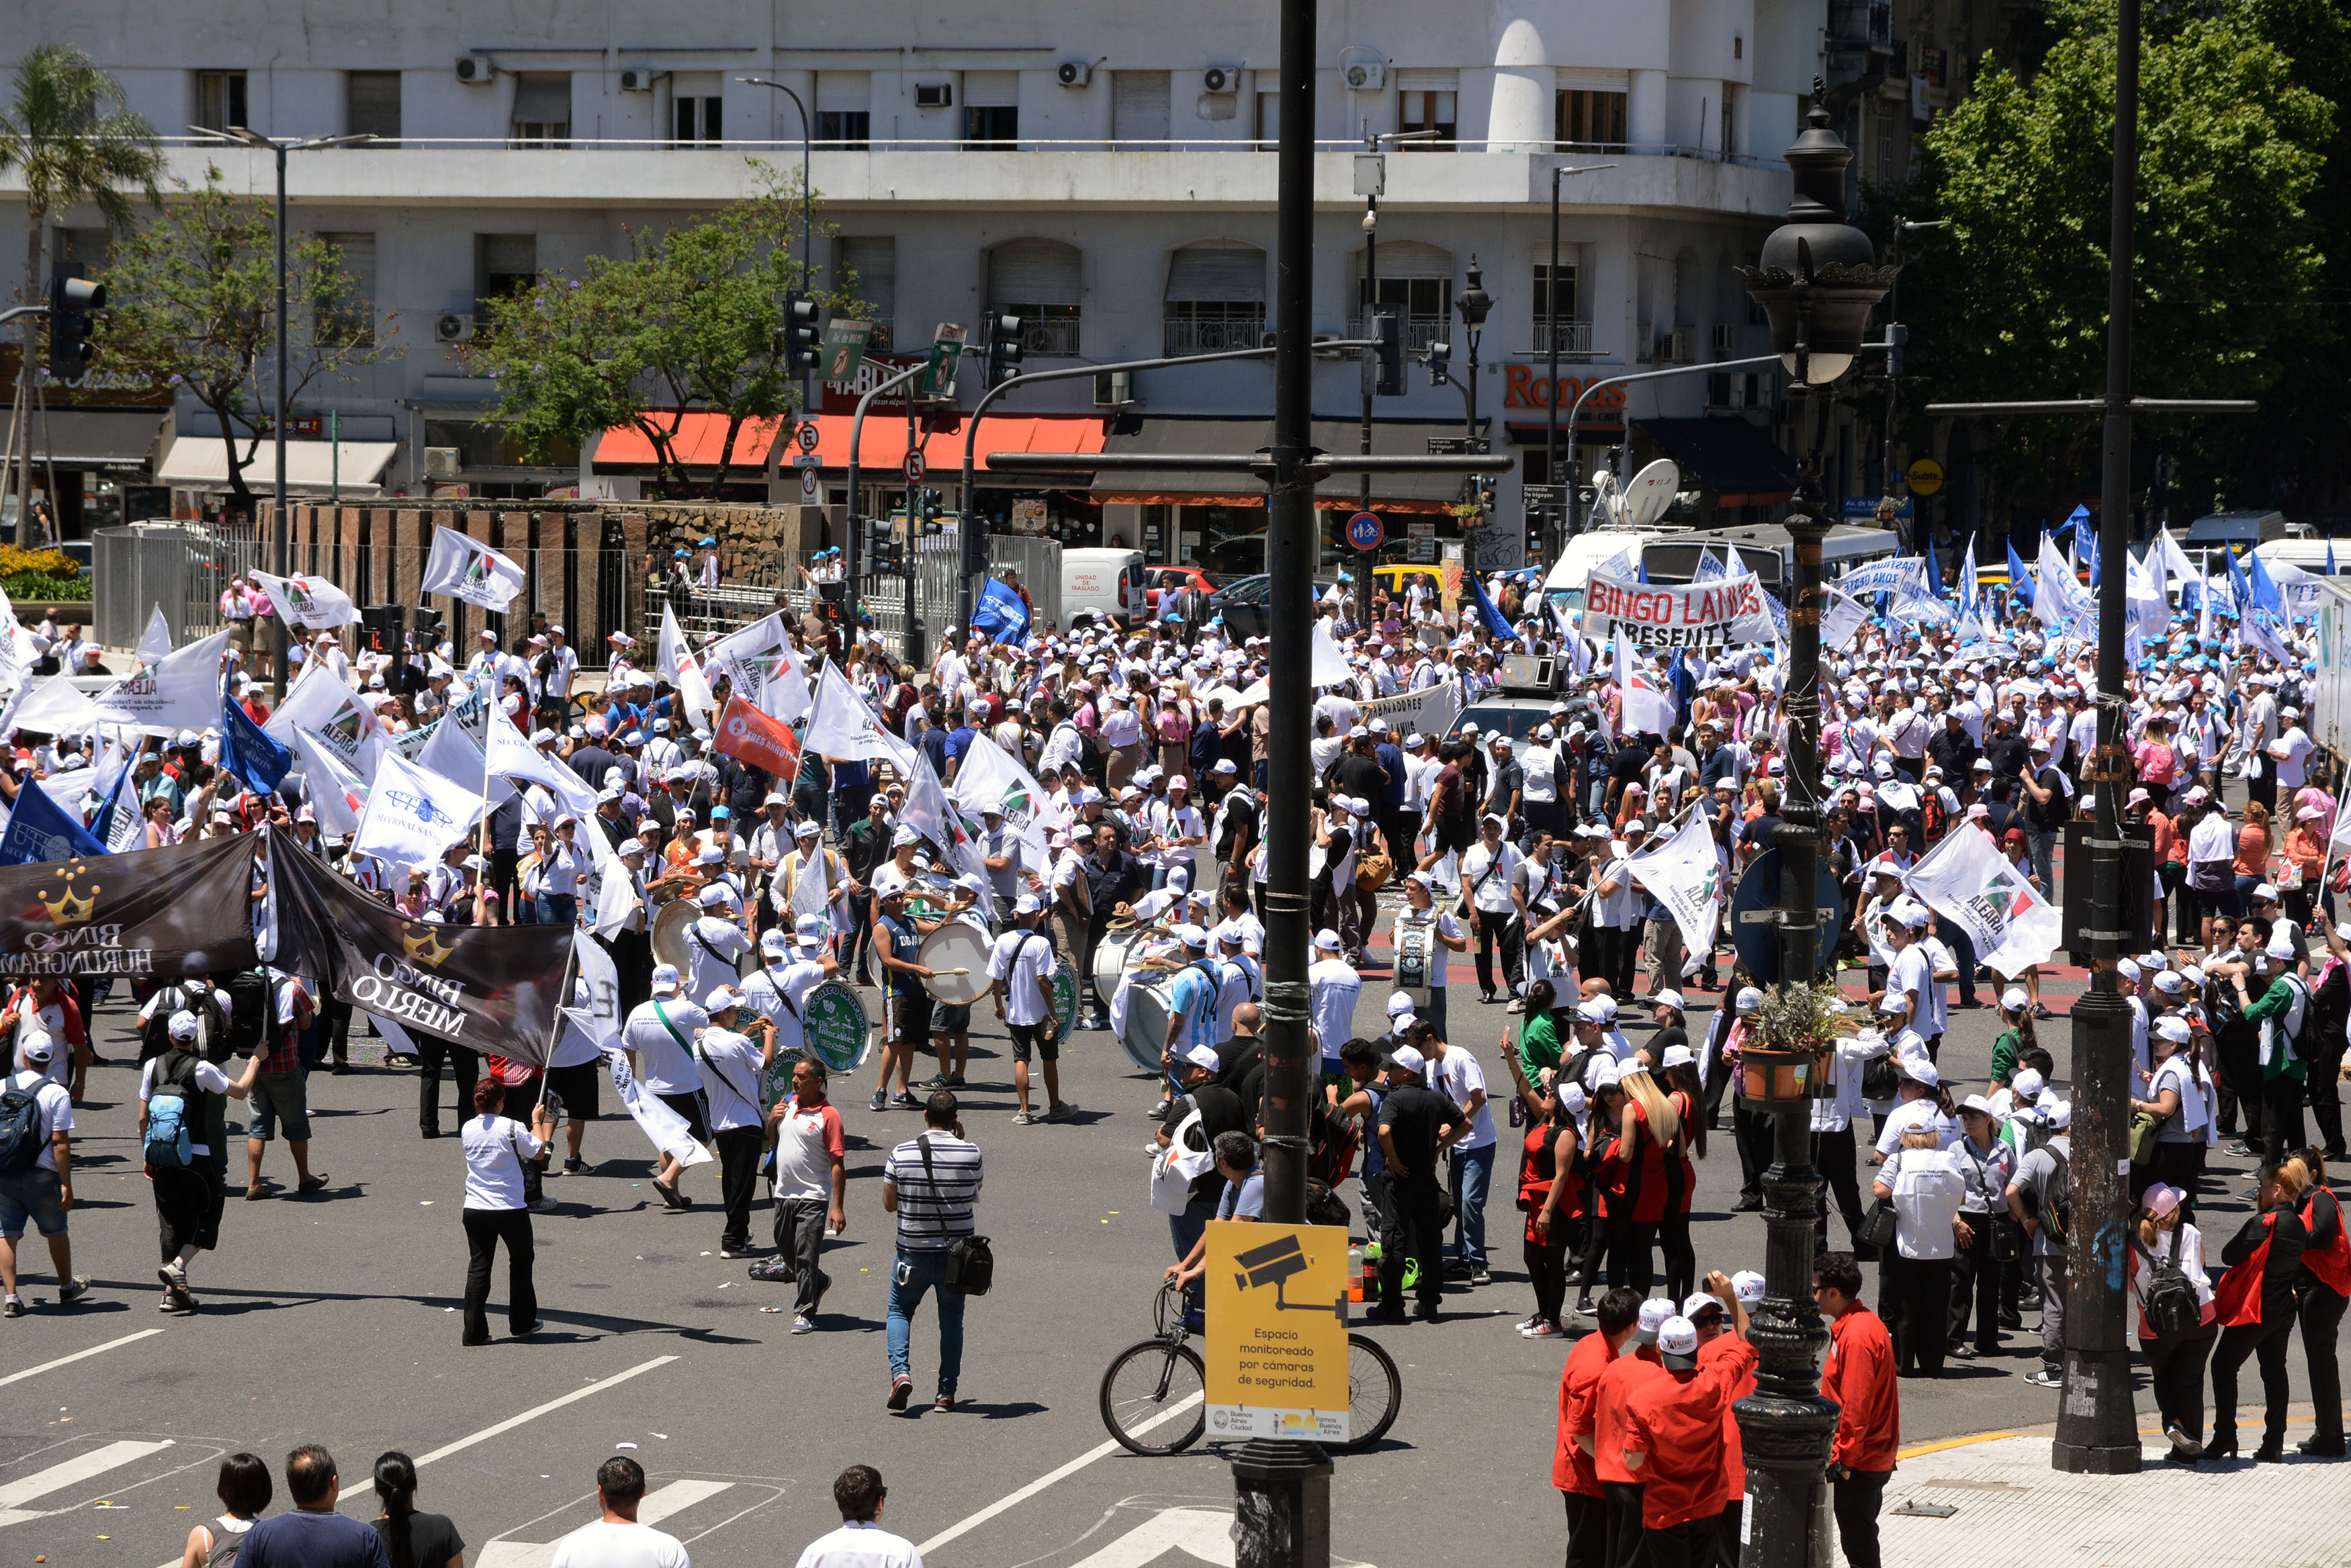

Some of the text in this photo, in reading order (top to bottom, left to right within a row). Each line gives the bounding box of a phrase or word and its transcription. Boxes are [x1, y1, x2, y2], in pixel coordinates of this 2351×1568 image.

[849, 333, 864, 344] MAYO
[1589, 580, 1672, 625] BINGO
[1684, 583, 1761, 624] LANUS
[1607, 620, 1736, 647] PRESENTE
[320, 723, 359, 757] ALEARA
[747, 731, 766, 746] TRES
[749, 724, 780, 744] BINGO
[1668, 884, 1690, 912] Sindicato de
[1675, 903, 1687, 919] Juegos
[1952, 904, 1960, 912] de
[1960, 911, 1979, 929] Juegos
[1978, 928, 1985, 937] de
[1967, 894, 2005, 936] ALEARA
[1979, 922, 2004, 957] Trabajadores
[1547, 970, 1568, 978] ALEARA
[808, 986, 866, 1029] Centro Murga
[1200, 990, 1217, 1023] 14
[819, 1025, 855, 1044] Intocables
[1254, 1328, 1298, 1341] Espacio
[1677, 1338, 1693, 1346] ALEARA
[1239, 1344, 1314, 1356] monitoreado
[1239, 1360, 1315, 1373] por cámaras
[1238, 1375, 1316, 1389] de seguridad.
